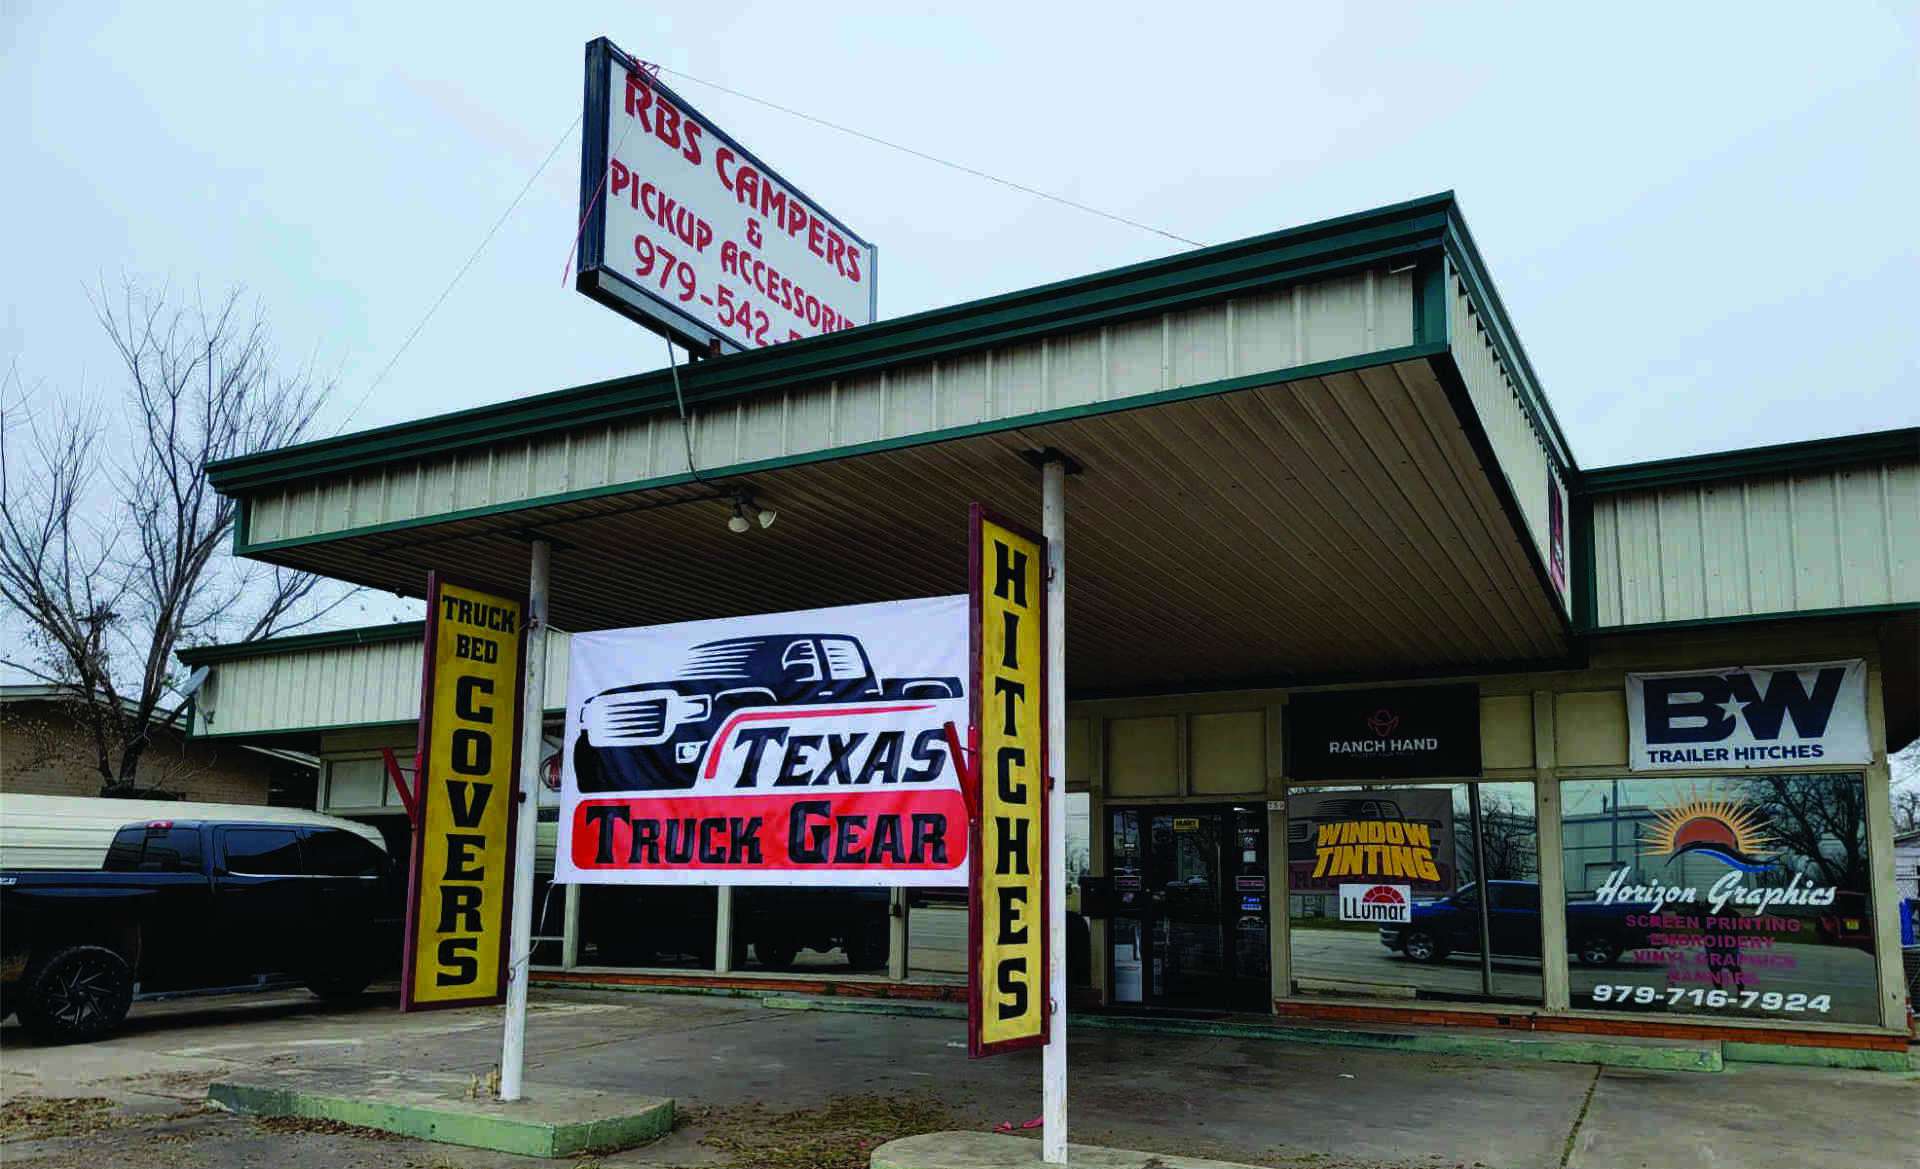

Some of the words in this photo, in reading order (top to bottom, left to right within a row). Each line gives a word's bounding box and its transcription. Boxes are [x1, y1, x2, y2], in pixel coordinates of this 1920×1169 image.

[625, 70, 702, 166] RBS
[716, 147, 861, 282] CAMPERS
[610, 157, 712, 253] PICKUP
[442, 595, 516, 634] TRUCK
[456, 633, 498, 664] BED
[733, 726, 949, 789] TEXAS
[1329, 740, 1386, 753] RANCH
[1390, 738, 1438, 751] HAND
[1647, 748, 1729, 763] TRAILER
[1734, 744, 1824, 760] HITCHES
[993, 539, 1029, 1021] HITCHES
[436, 674, 495, 988] COVERS
[586, 804, 763, 865] TRUCK
[788, 800, 949, 865] GEAR
[1317, 821, 1431, 848] WINDOW
[1312, 844, 1440, 881] TINTING
[1343, 897, 1406, 920] LLumar
[1596, 866, 1697, 913] Horizon
[1707, 870, 1838, 915] Graphics
[1626, 914, 1699, 929] SCREEN
[1706, 916, 1801, 932] PRINTING
[1592, 984, 1832, 1013] 979-716-7924
